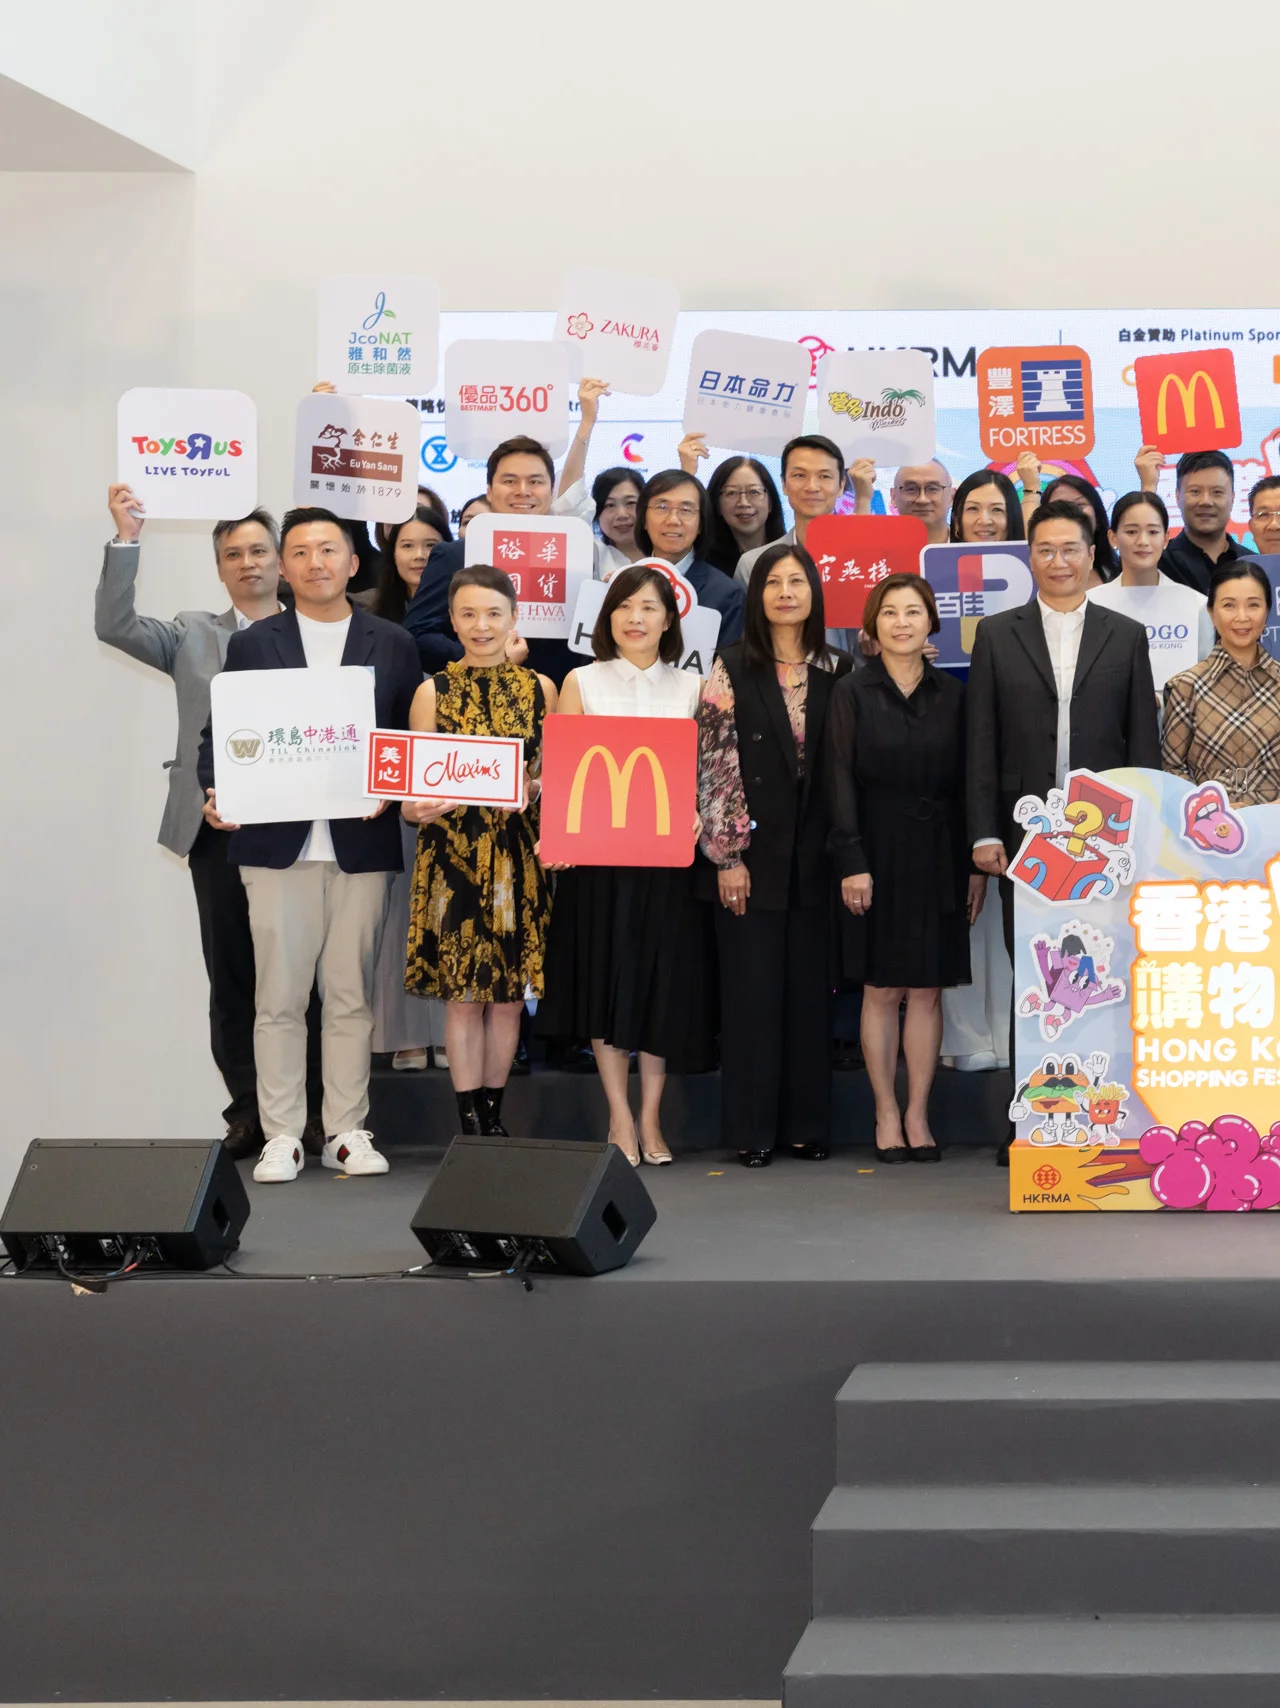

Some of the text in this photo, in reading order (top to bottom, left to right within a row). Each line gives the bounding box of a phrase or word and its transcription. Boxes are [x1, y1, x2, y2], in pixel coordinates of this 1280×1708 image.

[600, 319, 660, 343] ZAKURA
[1181, 329, 1244, 341] Platinum
[348, 347, 412, 361] 雅和然
[347, 362, 412, 375] 原生除菌液
[459, 384, 498, 404] 優品
[699, 370, 796, 403] 日本命力
[460, 404, 497, 412] BESTMART
[862, 399, 906, 419] Indo
[352, 428, 399, 450] 余仁生
[989, 424, 1086, 448] FORTRESS
[145, 466, 177, 476] LIVE
[349, 459, 398, 474] Eu Yan Sang
[1145, 624, 1188, 640] OGO
[268, 724, 360, 746] 環島中港通
[297, 745, 357, 754] Chinalink
[424, 752, 501, 787] Maxim's
[1137, 1037, 1237, 1063] HONG
[1136, 1068, 1249, 1088] SHOPPING
[1023, 1193, 1071, 1203] HKRMA
